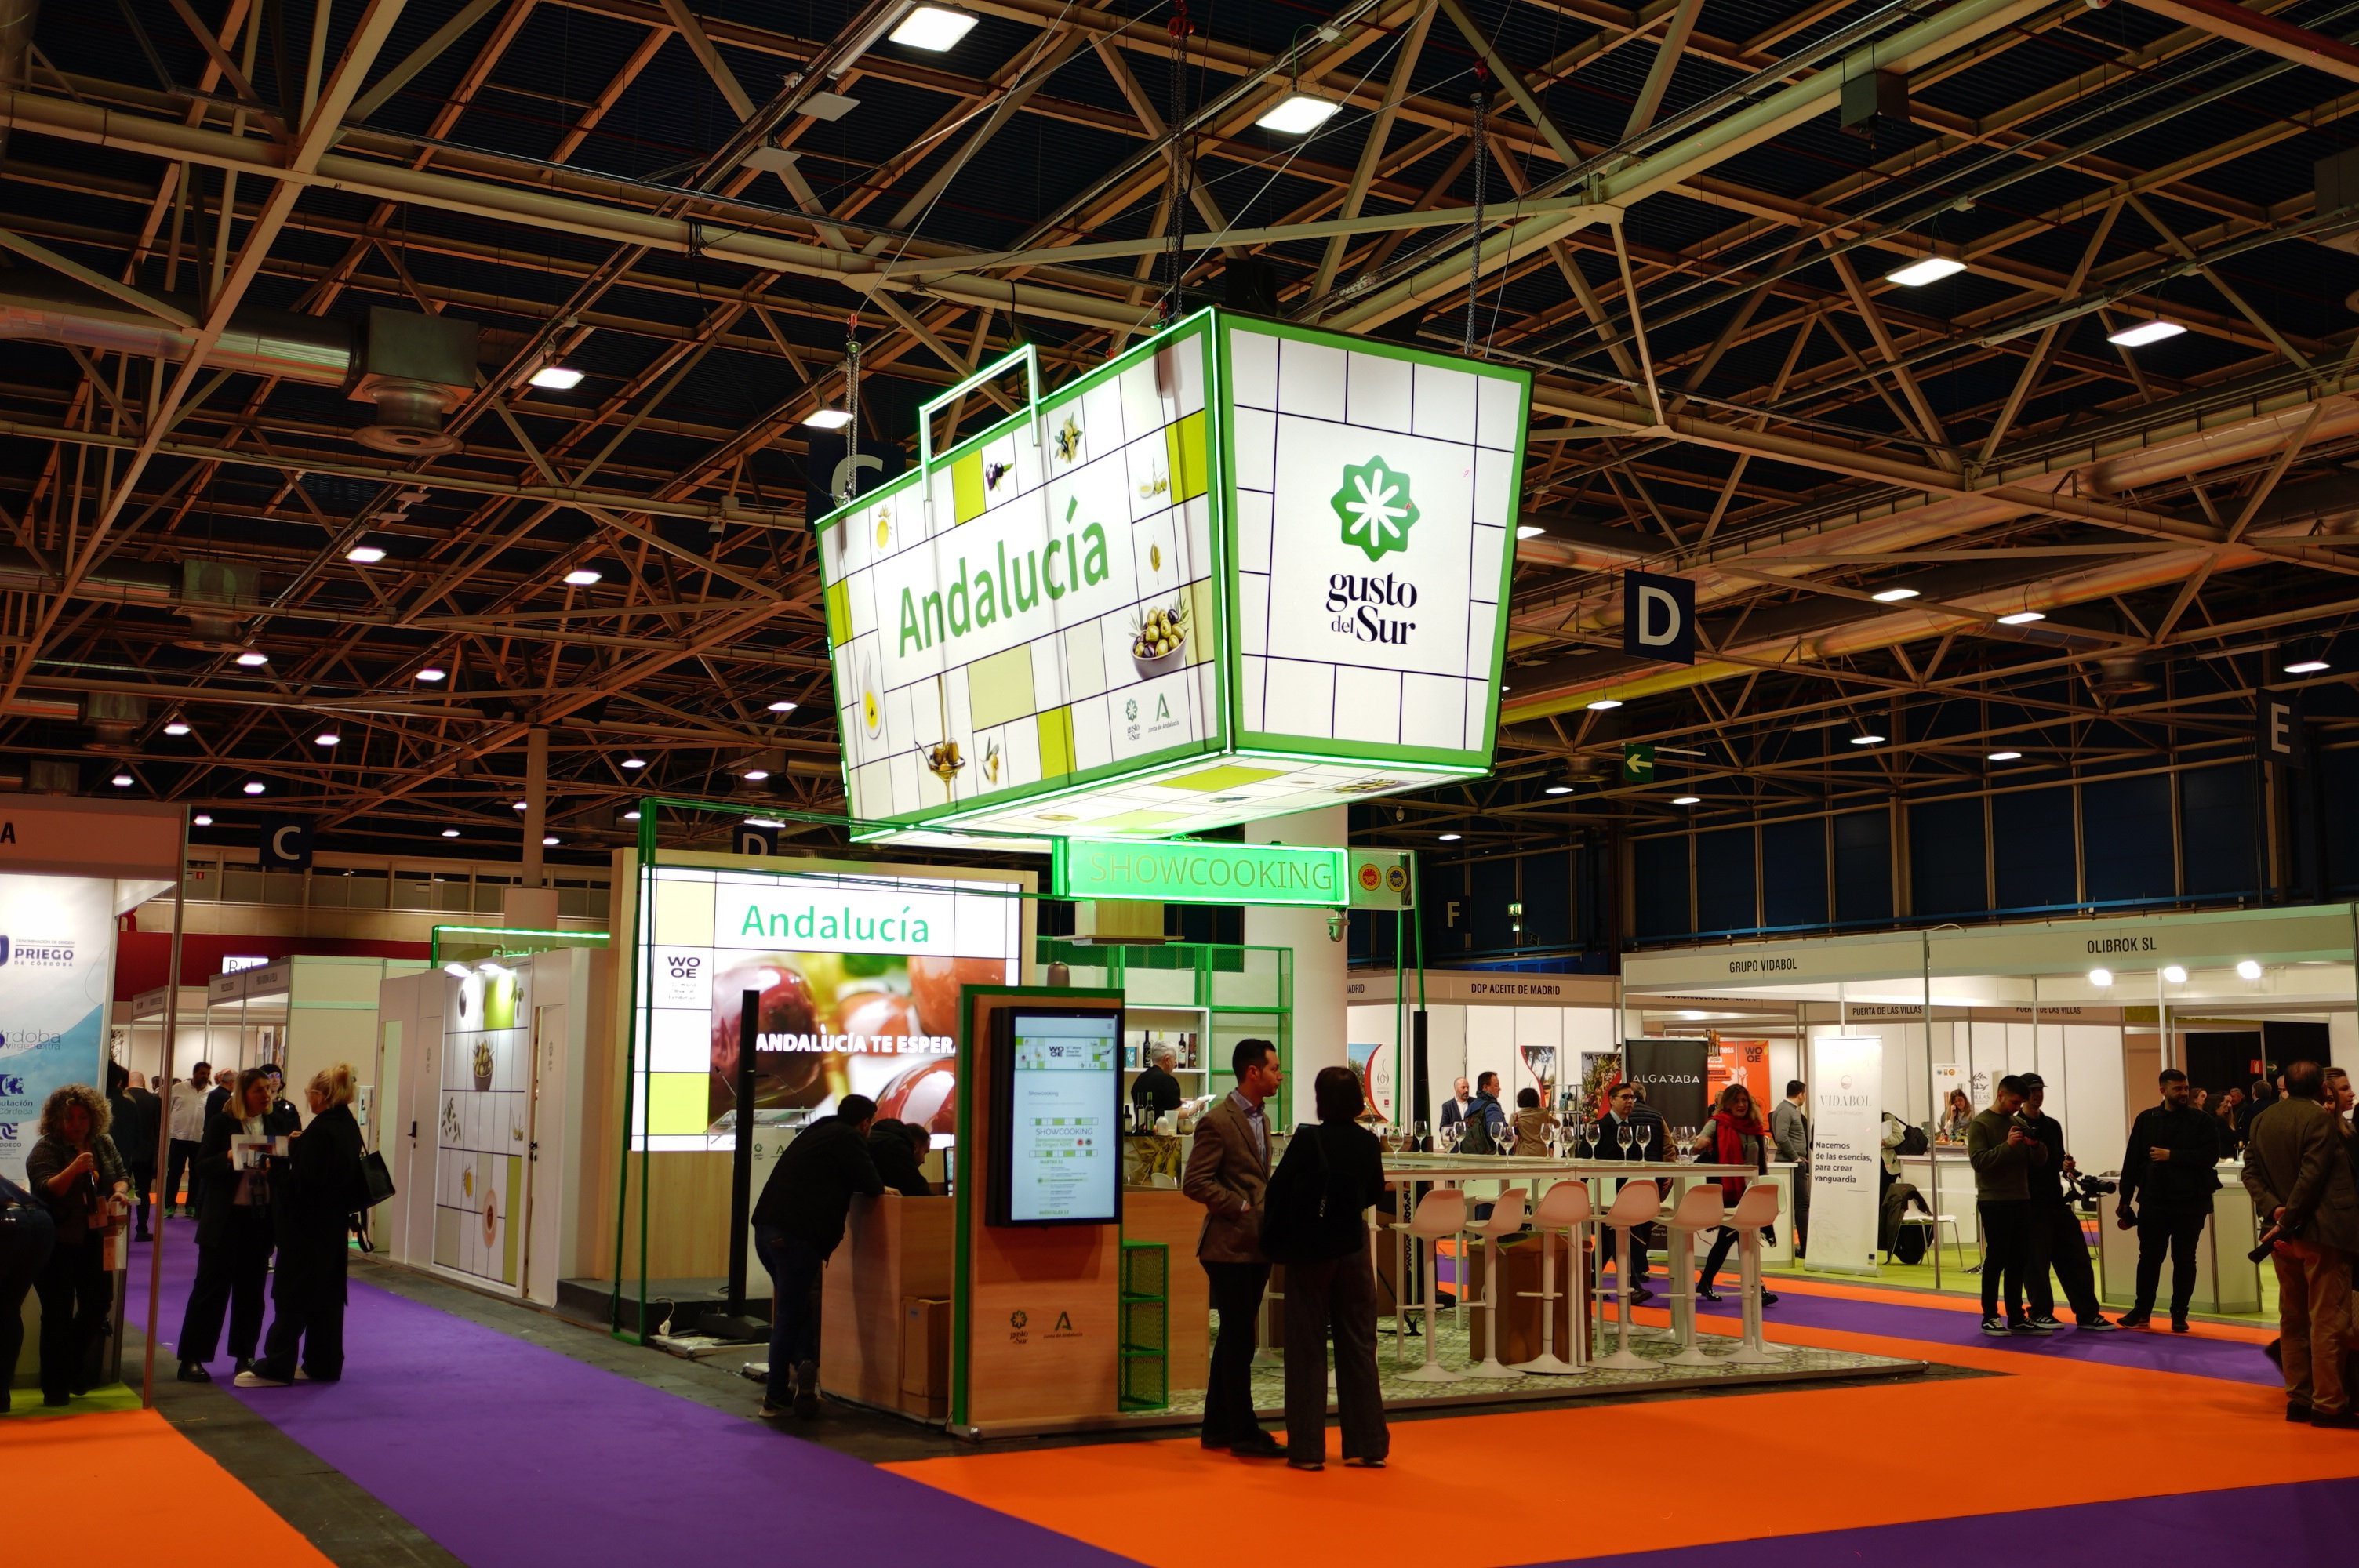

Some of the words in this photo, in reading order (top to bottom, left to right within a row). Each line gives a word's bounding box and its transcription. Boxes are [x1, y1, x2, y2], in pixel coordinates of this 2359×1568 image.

[900, 495, 1109, 659] Andalucía
[1326, 572, 1417, 612] gusto
[1639, 586, 1680, 646] D
[1331, 615, 1354, 633] del
[1357, 605, 1416, 644] Sur
[2271, 702, 2290, 753] E
[272, 826, 302, 860] C
[742, 833, 768, 855] D
[1090, 853, 1332, 890] SHOWCOOKING
[1448, 902, 1460, 927] F
[741, 905, 929, 942] Andalucía
[2088, 938, 2138, 953] OLIBROK
[2142, 937, 2157, 951] SL
[15, 948, 74, 960] PRIEGO
[667, 956, 700, 967] WO
[671, 968, 696, 978] OE
[1729, 960, 1758, 973] GRUPO
[1761, 958, 1797, 971] VIDABOL
[1347, 983, 1365, 993] ADRID
[1471, 983, 1487, 993] DOP
[1489, 984, 1516, 994] ACEITE
[1518, 985, 1528, 994] DE
[1530, 985, 1560, 996] MADRID
[1852, 1007, 1876, 1016] PUERTA
[1877, 1007, 1885, 1015] DE
[1887, 1006, 1899, 1015] LAS
[1900, 1005, 1922, 1014] VILLAS
[756, 1033, 867, 1053] ANDALUCÍA
[871, 1036, 892, 1053] TE
[896, 1036, 955, 1054] ESPER
[1633, 1074, 1700, 1083] ALGARABA
[1820, 1095, 1871, 1106] VIDABOL
[1838, 1153, 1872, 1163] esencias,
[1814, 1174, 1856, 1184] vanguardia
